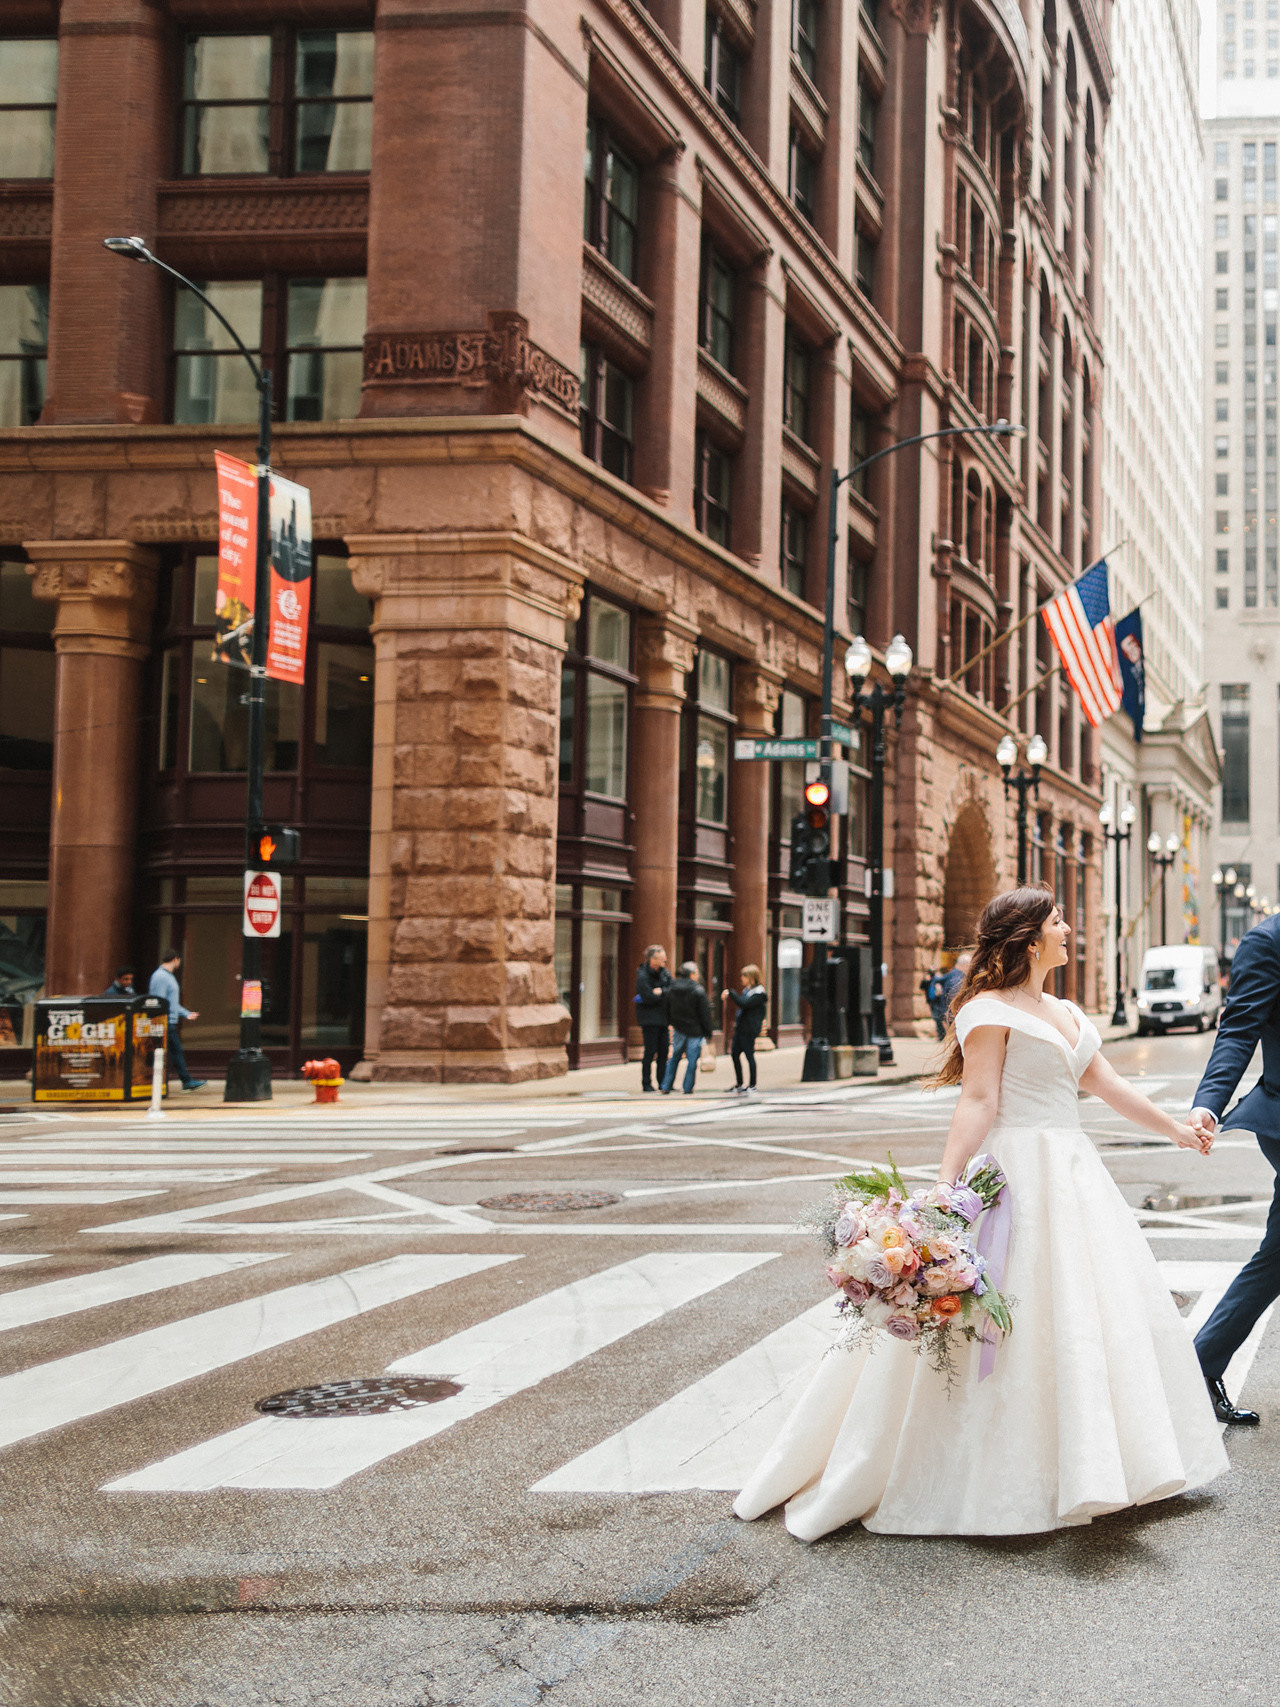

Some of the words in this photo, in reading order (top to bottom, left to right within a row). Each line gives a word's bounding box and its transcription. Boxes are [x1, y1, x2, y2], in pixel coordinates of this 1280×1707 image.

[375, 340, 456, 374] ADAMS
[220, 488, 242, 510] The
[763, 741, 806, 757] Adams
[250, 883, 260, 896] DO
[261, 884, 275, 897] NOT
[807, 901, 831, 911] ONE
[252, 911, 273, 924] ENTER
[807, 913, 830, 922] WAY
[47, 1013, 83, 1026] van
